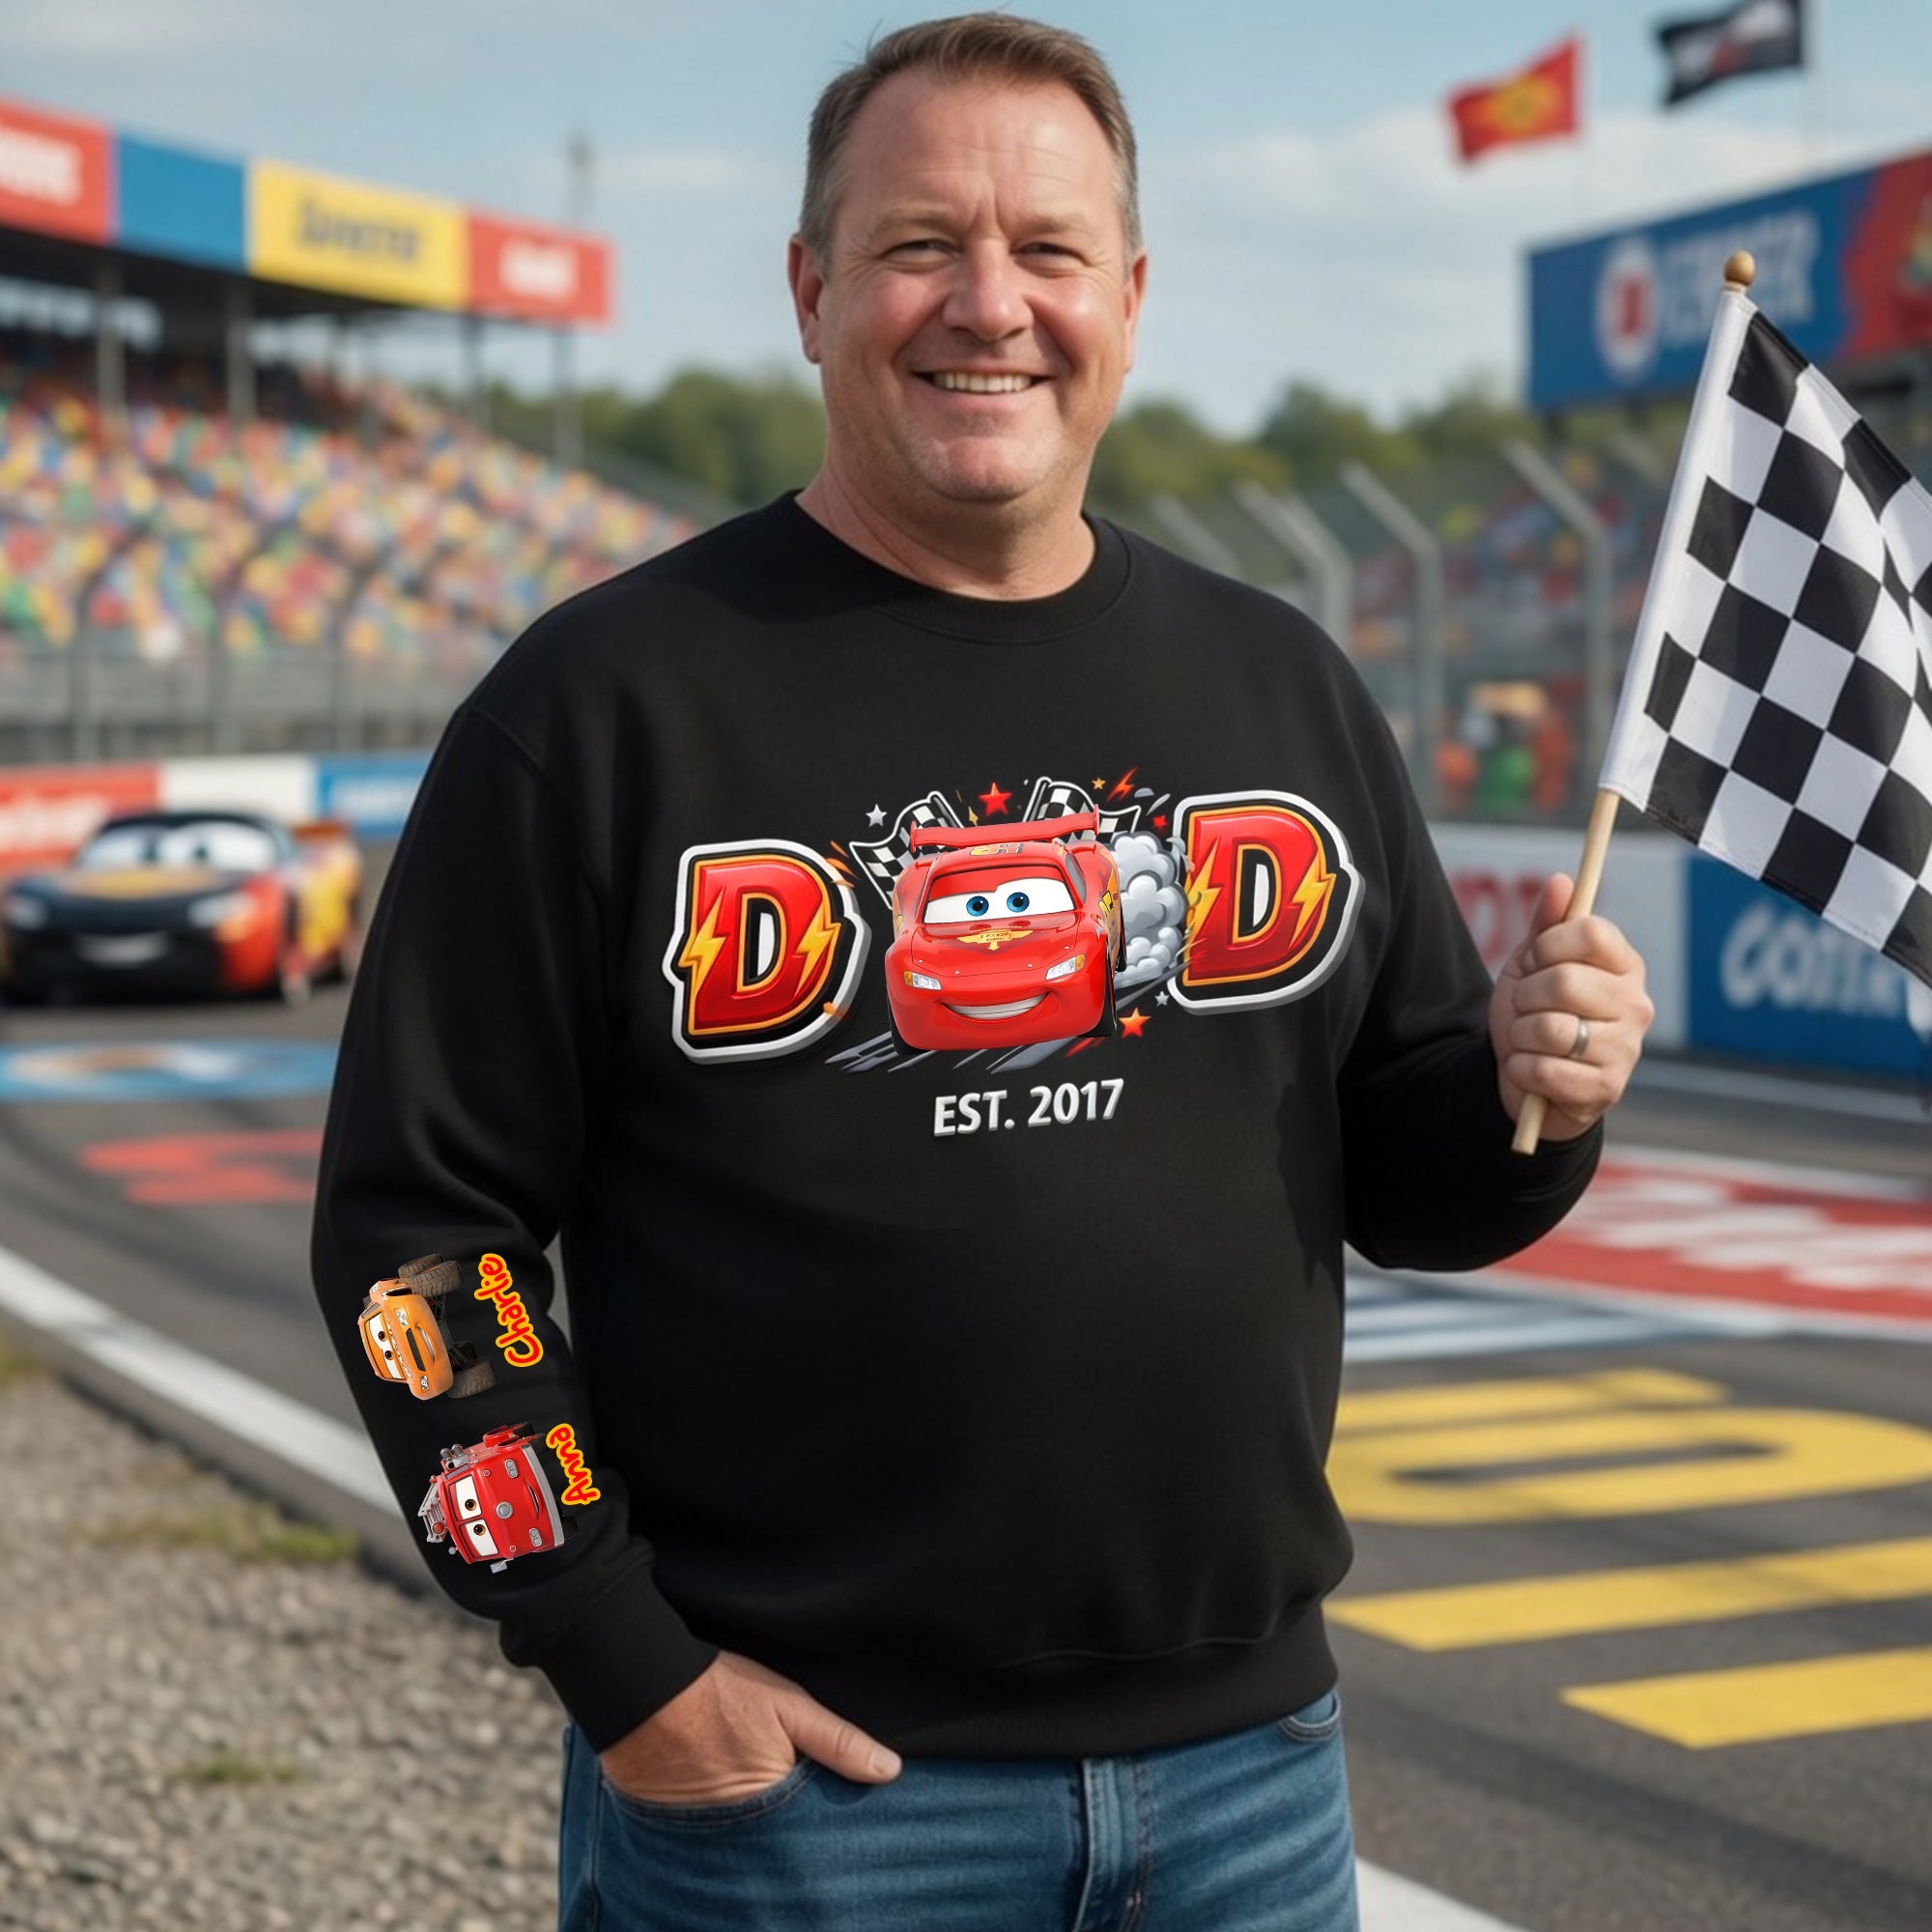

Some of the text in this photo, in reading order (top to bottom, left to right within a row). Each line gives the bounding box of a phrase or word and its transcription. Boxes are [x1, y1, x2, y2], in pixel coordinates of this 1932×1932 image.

[933, 1077, 1124, 1137] EST. 2017
[475, 1254, 543, 1367] Charlie
[546, 1423, 601, 1506] Anna
